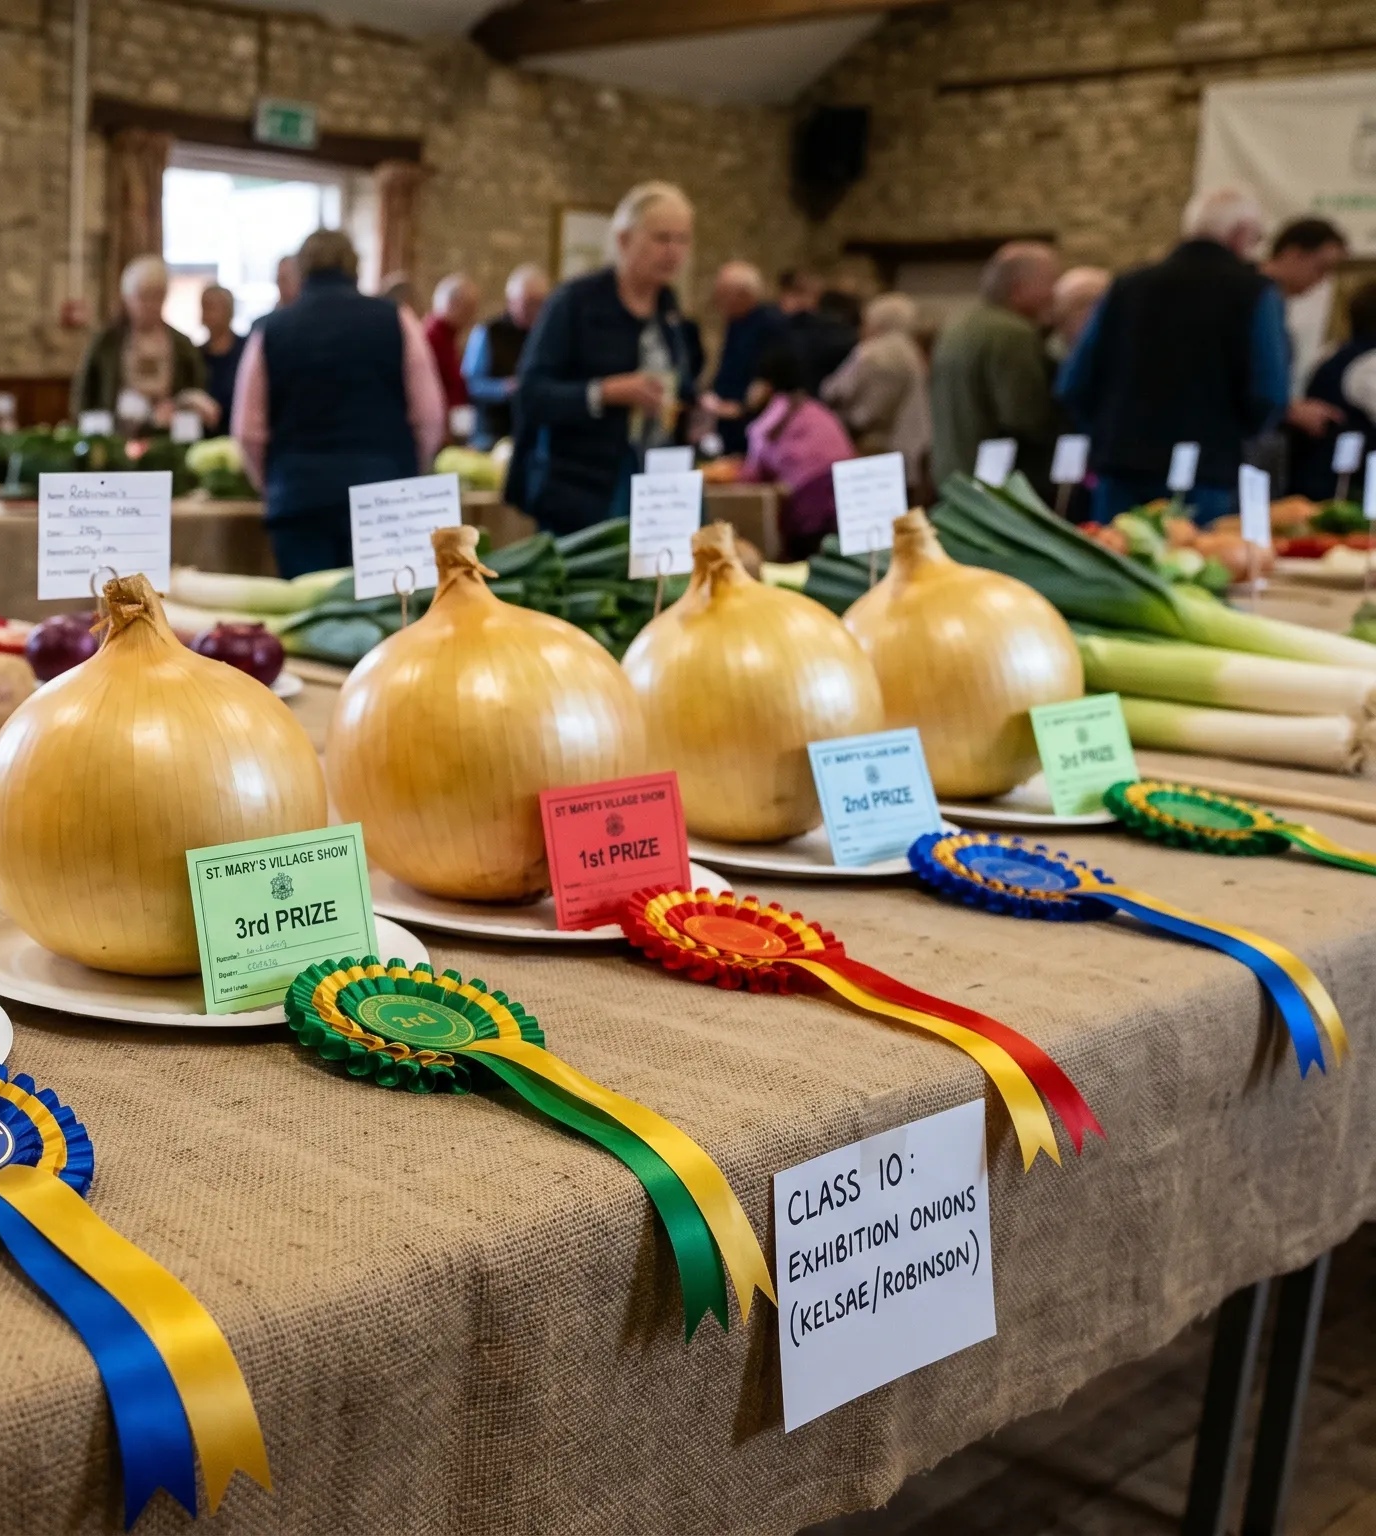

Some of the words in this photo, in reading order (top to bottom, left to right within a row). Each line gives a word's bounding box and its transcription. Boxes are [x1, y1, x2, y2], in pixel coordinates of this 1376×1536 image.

[569, 800, 603, 815] MARY'S
[605, 795, 639, 809] VILLAGE
[842, 793, 870, 813] 2nd
[871, 785, 915, 809] PRIZE
[206, 867, 222, 880] ST.
[225, 859, 267, 877] MARY'S
[269, 851, 314, 869] VILLAGE
[317, 845, 349, 861] SHOW
[579, 846, 606, 869] 1st
[609, 837, 661, 864] PRIZE
[235, 913, 269, 939] 3rd
[275, 900, 338, 932] PRIZE
[787, 1168, 861, 1226] CLASS
[789, 1213, 899, 1283] EXHIBITION
[910, 1184, 976, 1232] ONIONS
[789, 1229, 980, 1348] (KELSAE/ROBINSON)
